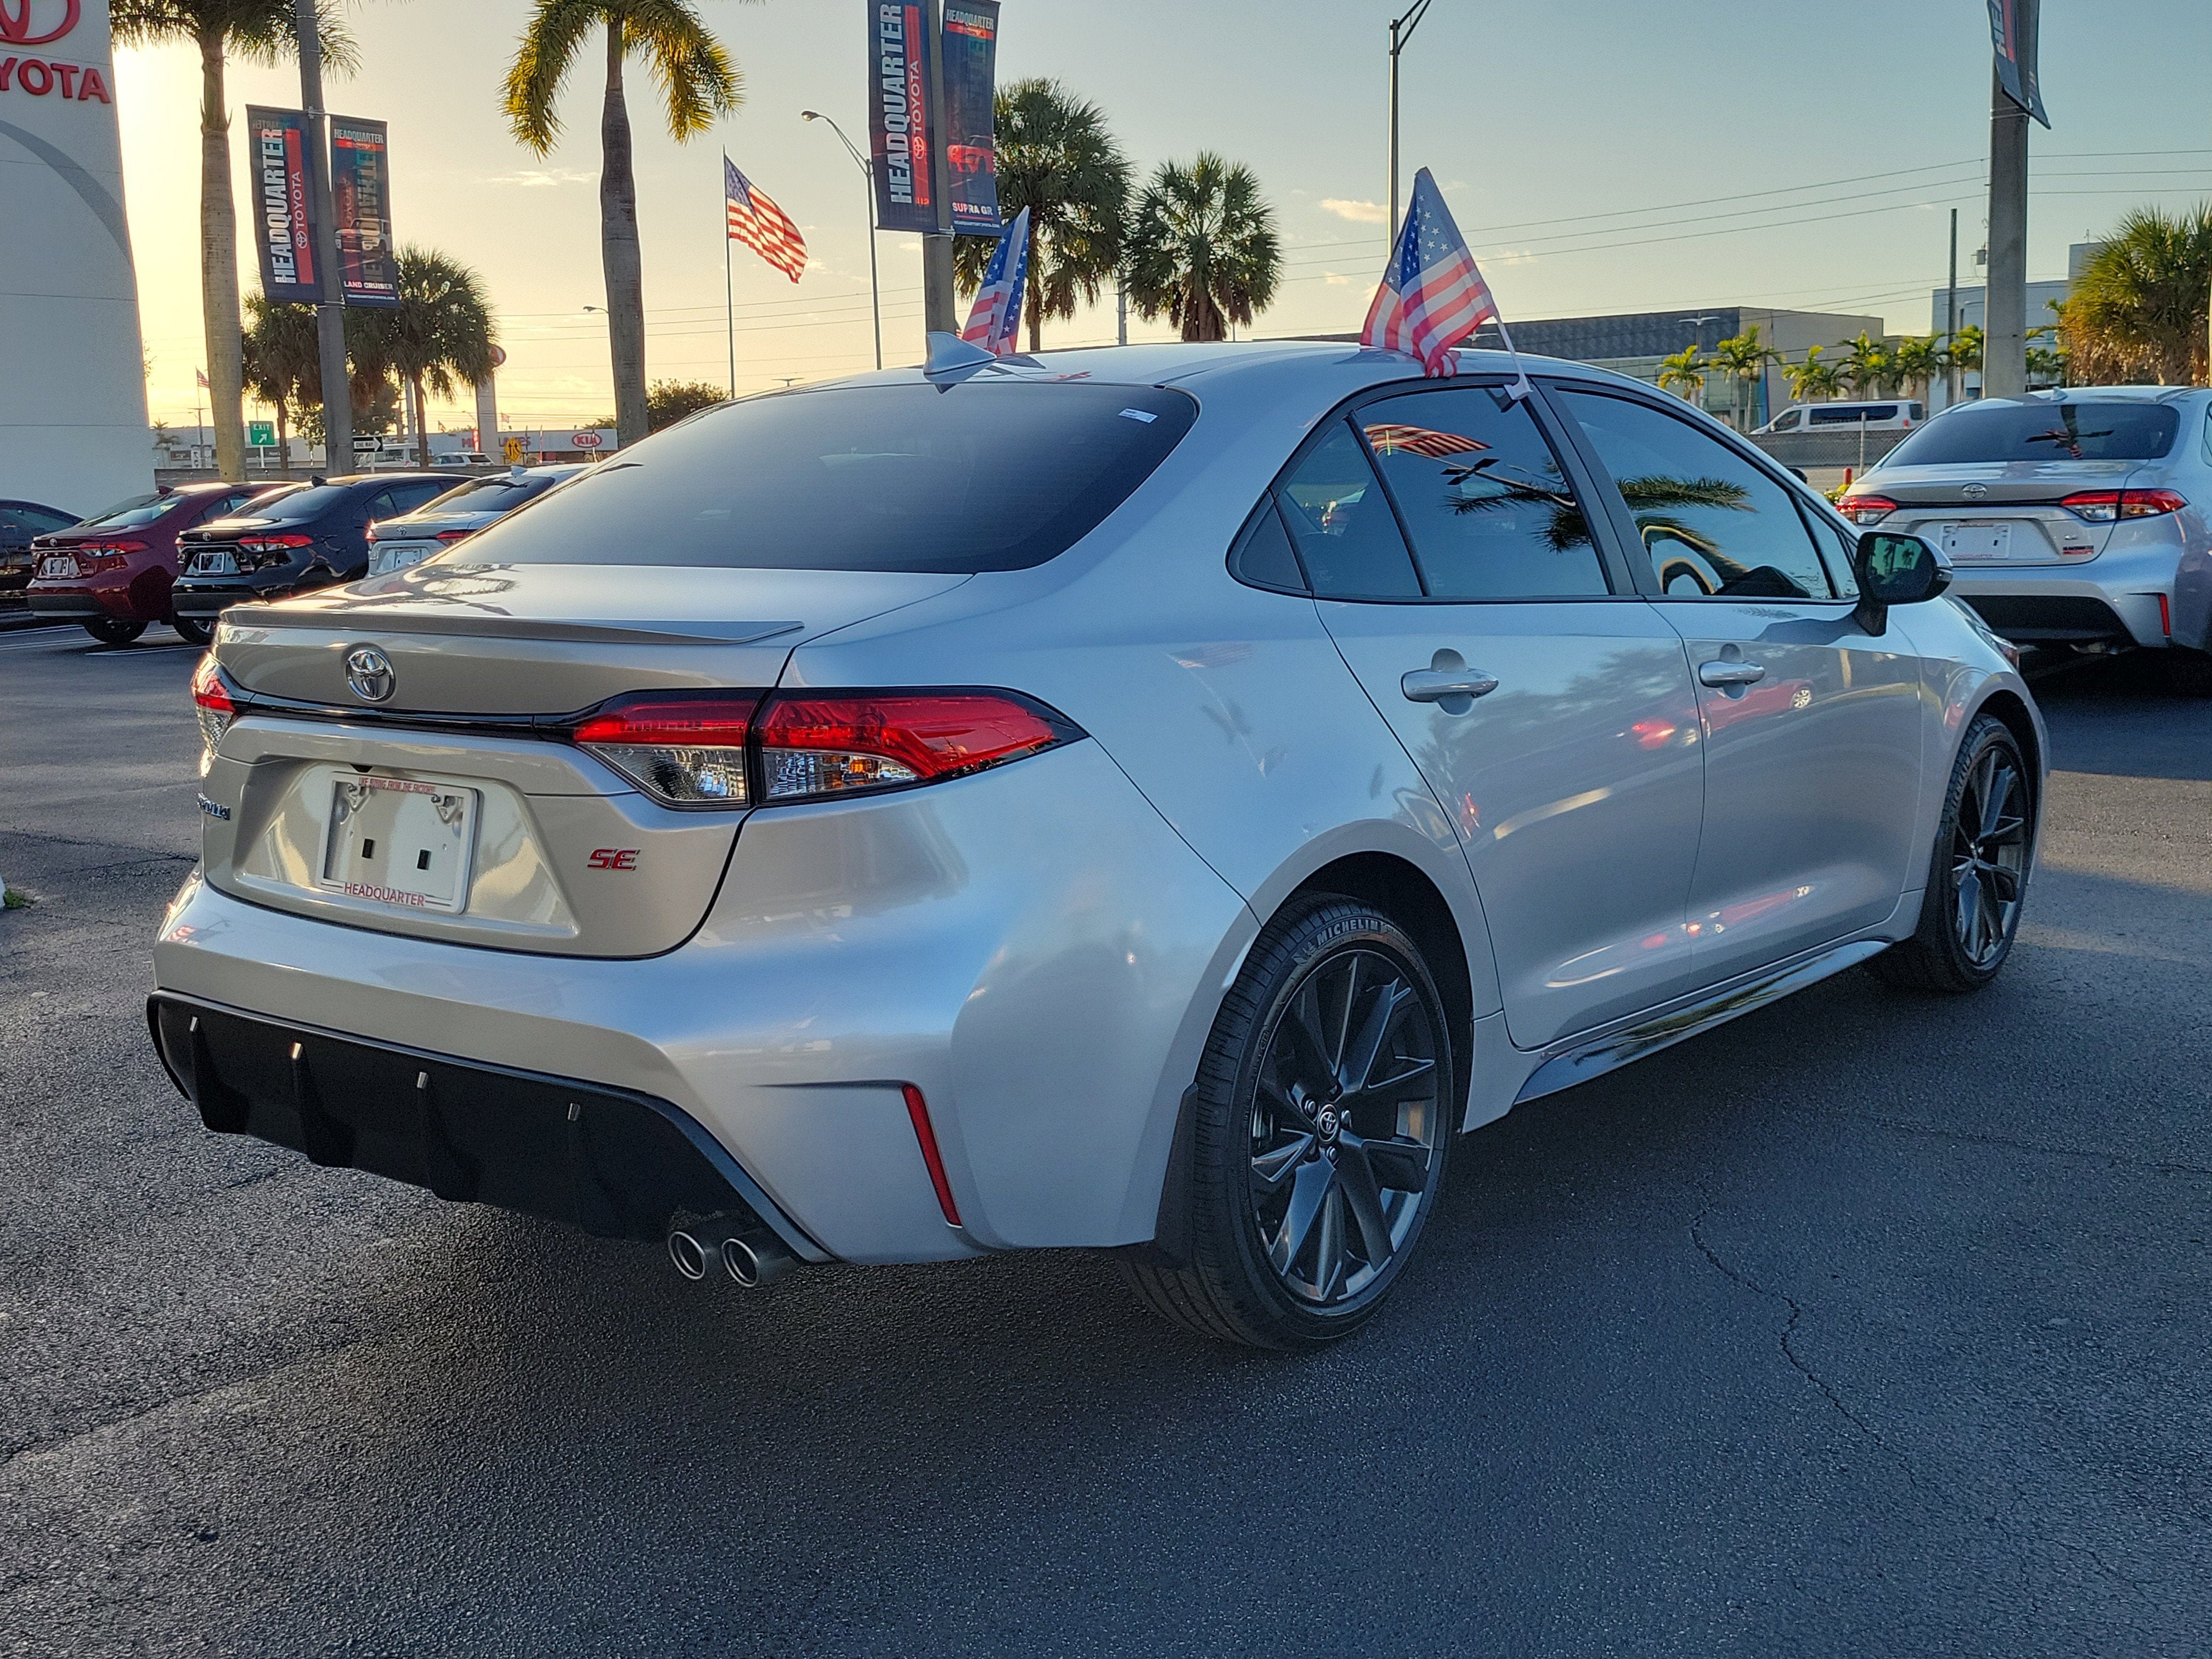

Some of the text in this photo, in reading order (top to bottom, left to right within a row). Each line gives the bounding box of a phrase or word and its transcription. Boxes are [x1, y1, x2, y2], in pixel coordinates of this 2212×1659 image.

[946, 9, 994, 30] HEADQUARTER
[880, 4, 912, 204] HEADQUARTER
[911, 60, 922, 133] TOYOTA
[334, 128, 384, 144] HEADQUARTER
[262, 128, 297, 284] HEADQUARTER
[292, 171, 305, 229] TOYOTA
[952, 202, 994, 216] SUPRA GR
[344, 280, 394, 290] LAND CRUISER
[577, 436, 598, 445] KIA
[587, 848, 640, 871] SE
[344, 882, 424, 906] HEADQUARTER
[1316, 918, 1379, 946] MICHELIN
